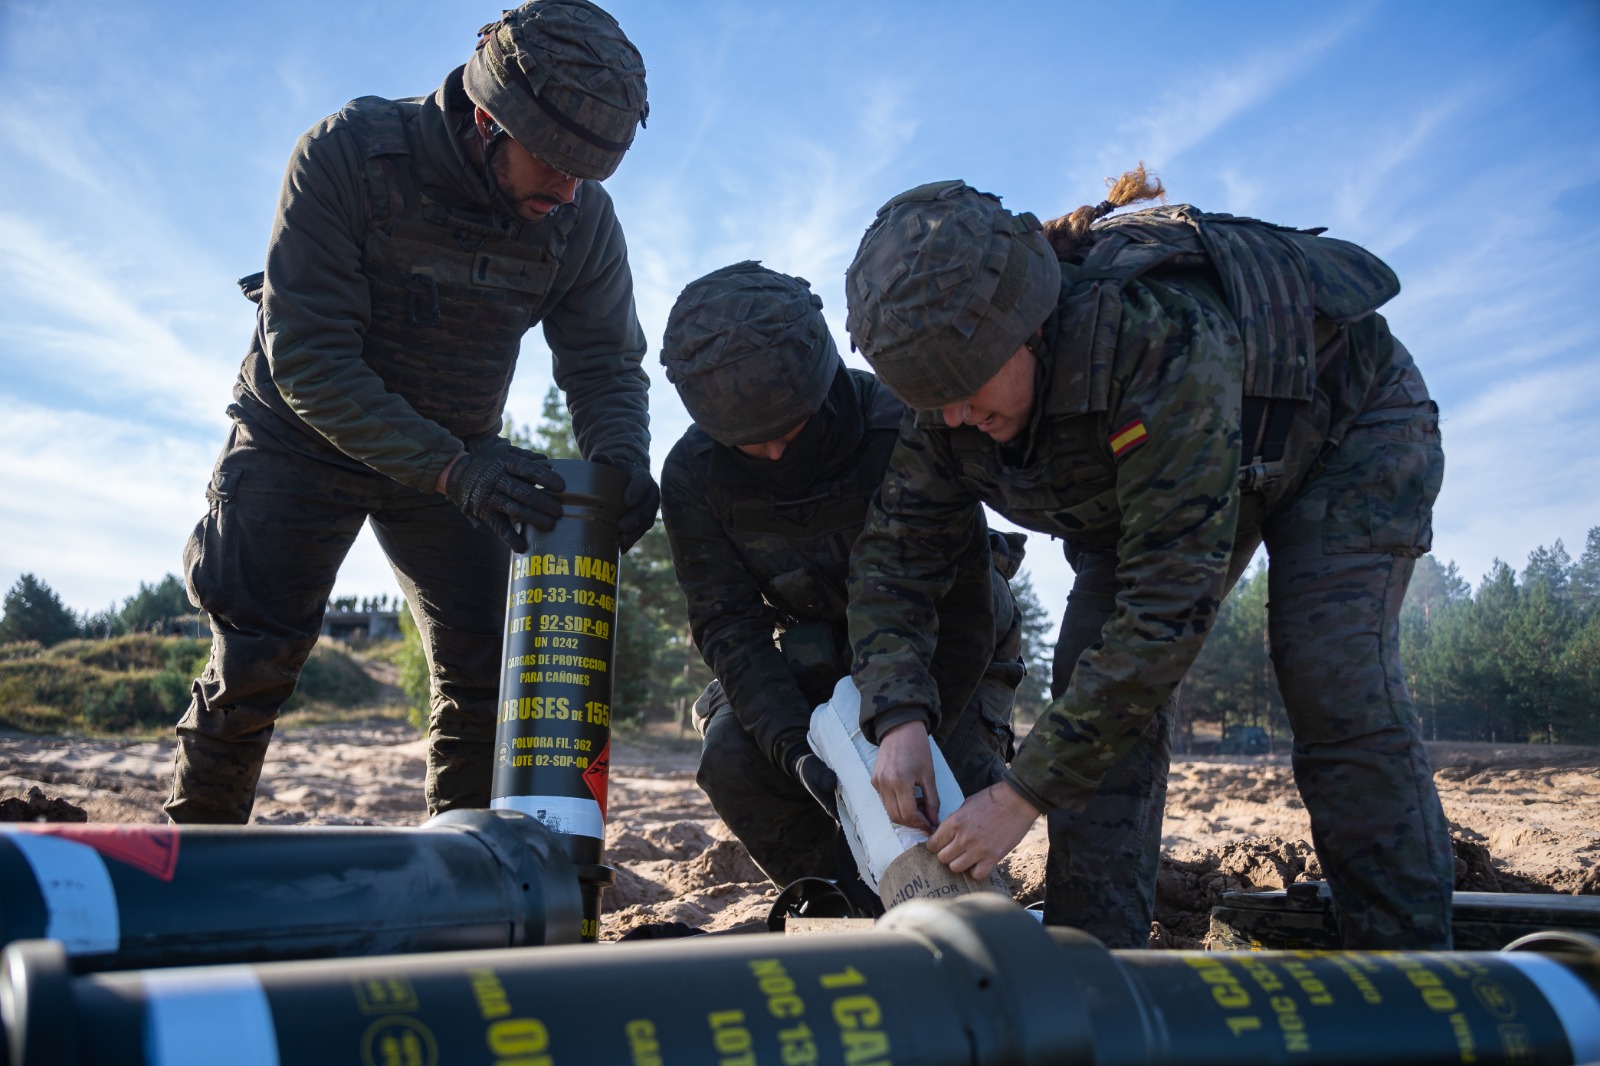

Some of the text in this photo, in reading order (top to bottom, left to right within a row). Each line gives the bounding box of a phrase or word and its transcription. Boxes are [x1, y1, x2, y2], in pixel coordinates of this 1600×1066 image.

[513, 554, 616, 586] CARGA M4A2
[516, 588, 615, 613] 1320-33-102-465
[510, 615, 609, 638] LOTE 92-SDP-09
[535, 637, 578, 649] UN 0242
[508, 654, 607, 672] CARGAS DE PROYECCION
[520, 670, 590, 686] PARA CAÑONES
[502, 697, 569, 722] OBUSES
[572, 710, 583, 721] DE
[585, 701, 609, 727] 155
[512, 737, 553, 749] POLVORA
[574, 739, 592, 751] 362
[512, 755, 532, 767] LOTE
[922, 884, 959, 899] CTOR
[831, 995, 893, 1066] CA
[778, 1021, 820, 1066] 13
